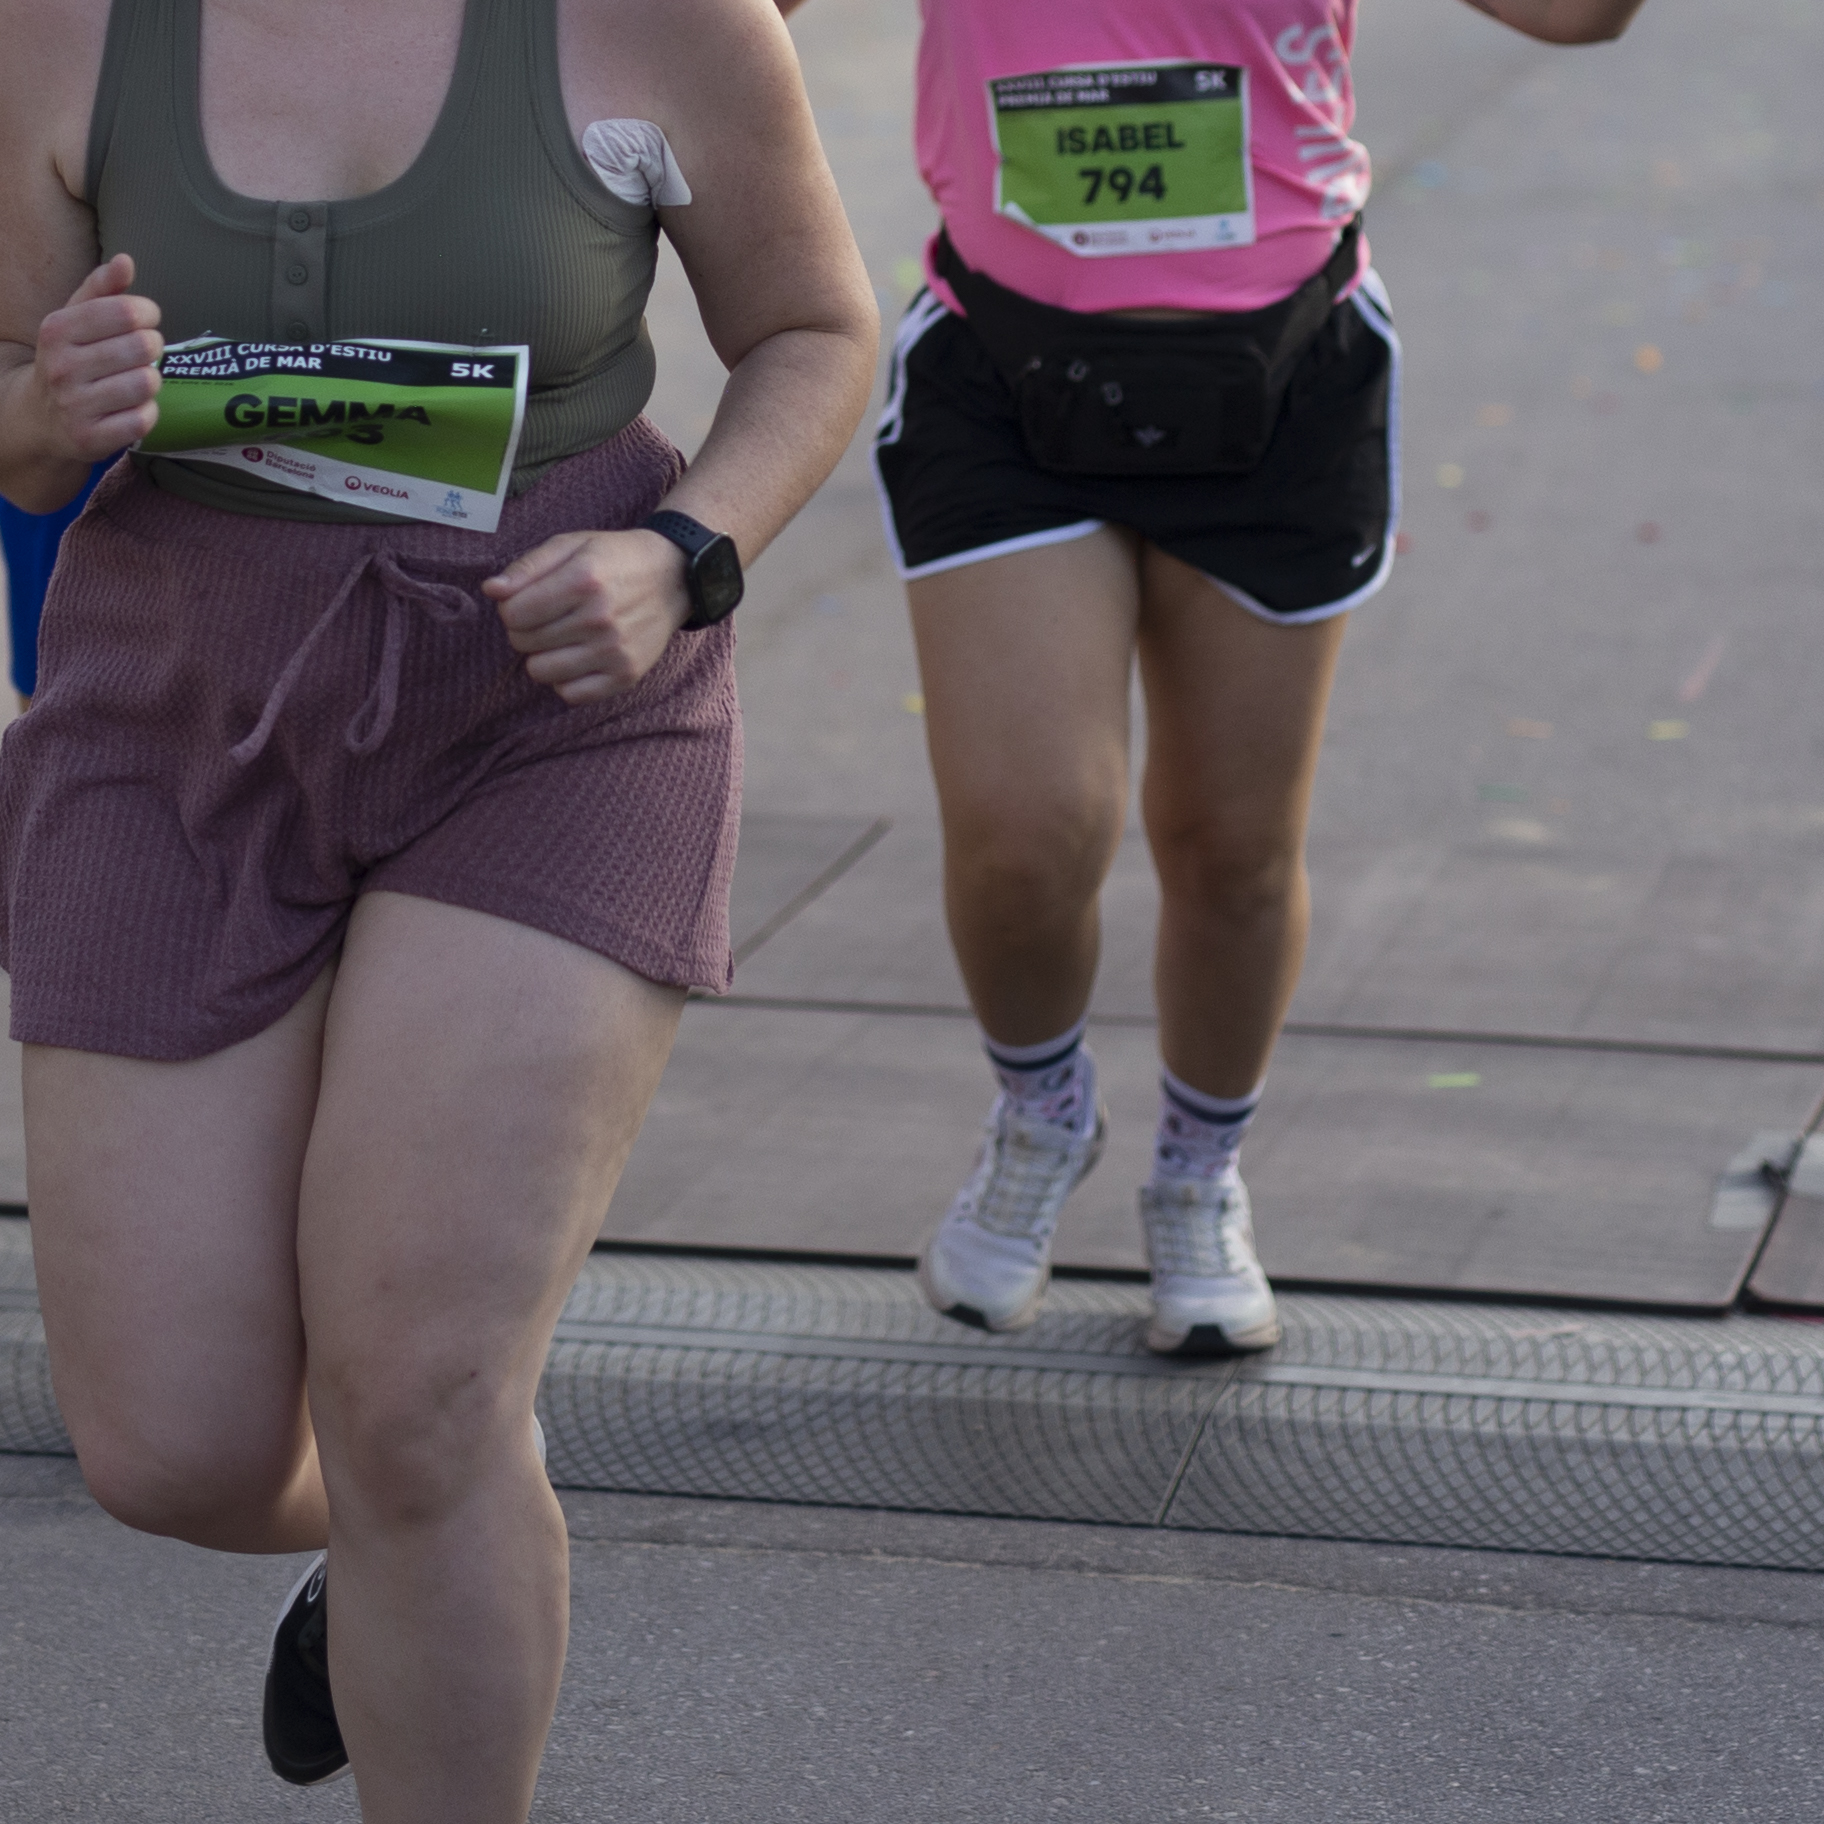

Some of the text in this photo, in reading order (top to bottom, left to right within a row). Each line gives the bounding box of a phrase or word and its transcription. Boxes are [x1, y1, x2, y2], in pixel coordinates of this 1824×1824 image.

[1056, 122, 1184, 155] ISABEL
[1080, 164, 1166, 205] 794
[166, 345, 232, 364] XXVIII
[162, 356, 322, 375] PREMIÀ DE MAR
[450, 362, 494, 379] 5K
[224, 393, 432, 429] GEMMA
[266, 450, 317, 472] Diputació
[363, 482, 409, 500] VEOLIA
